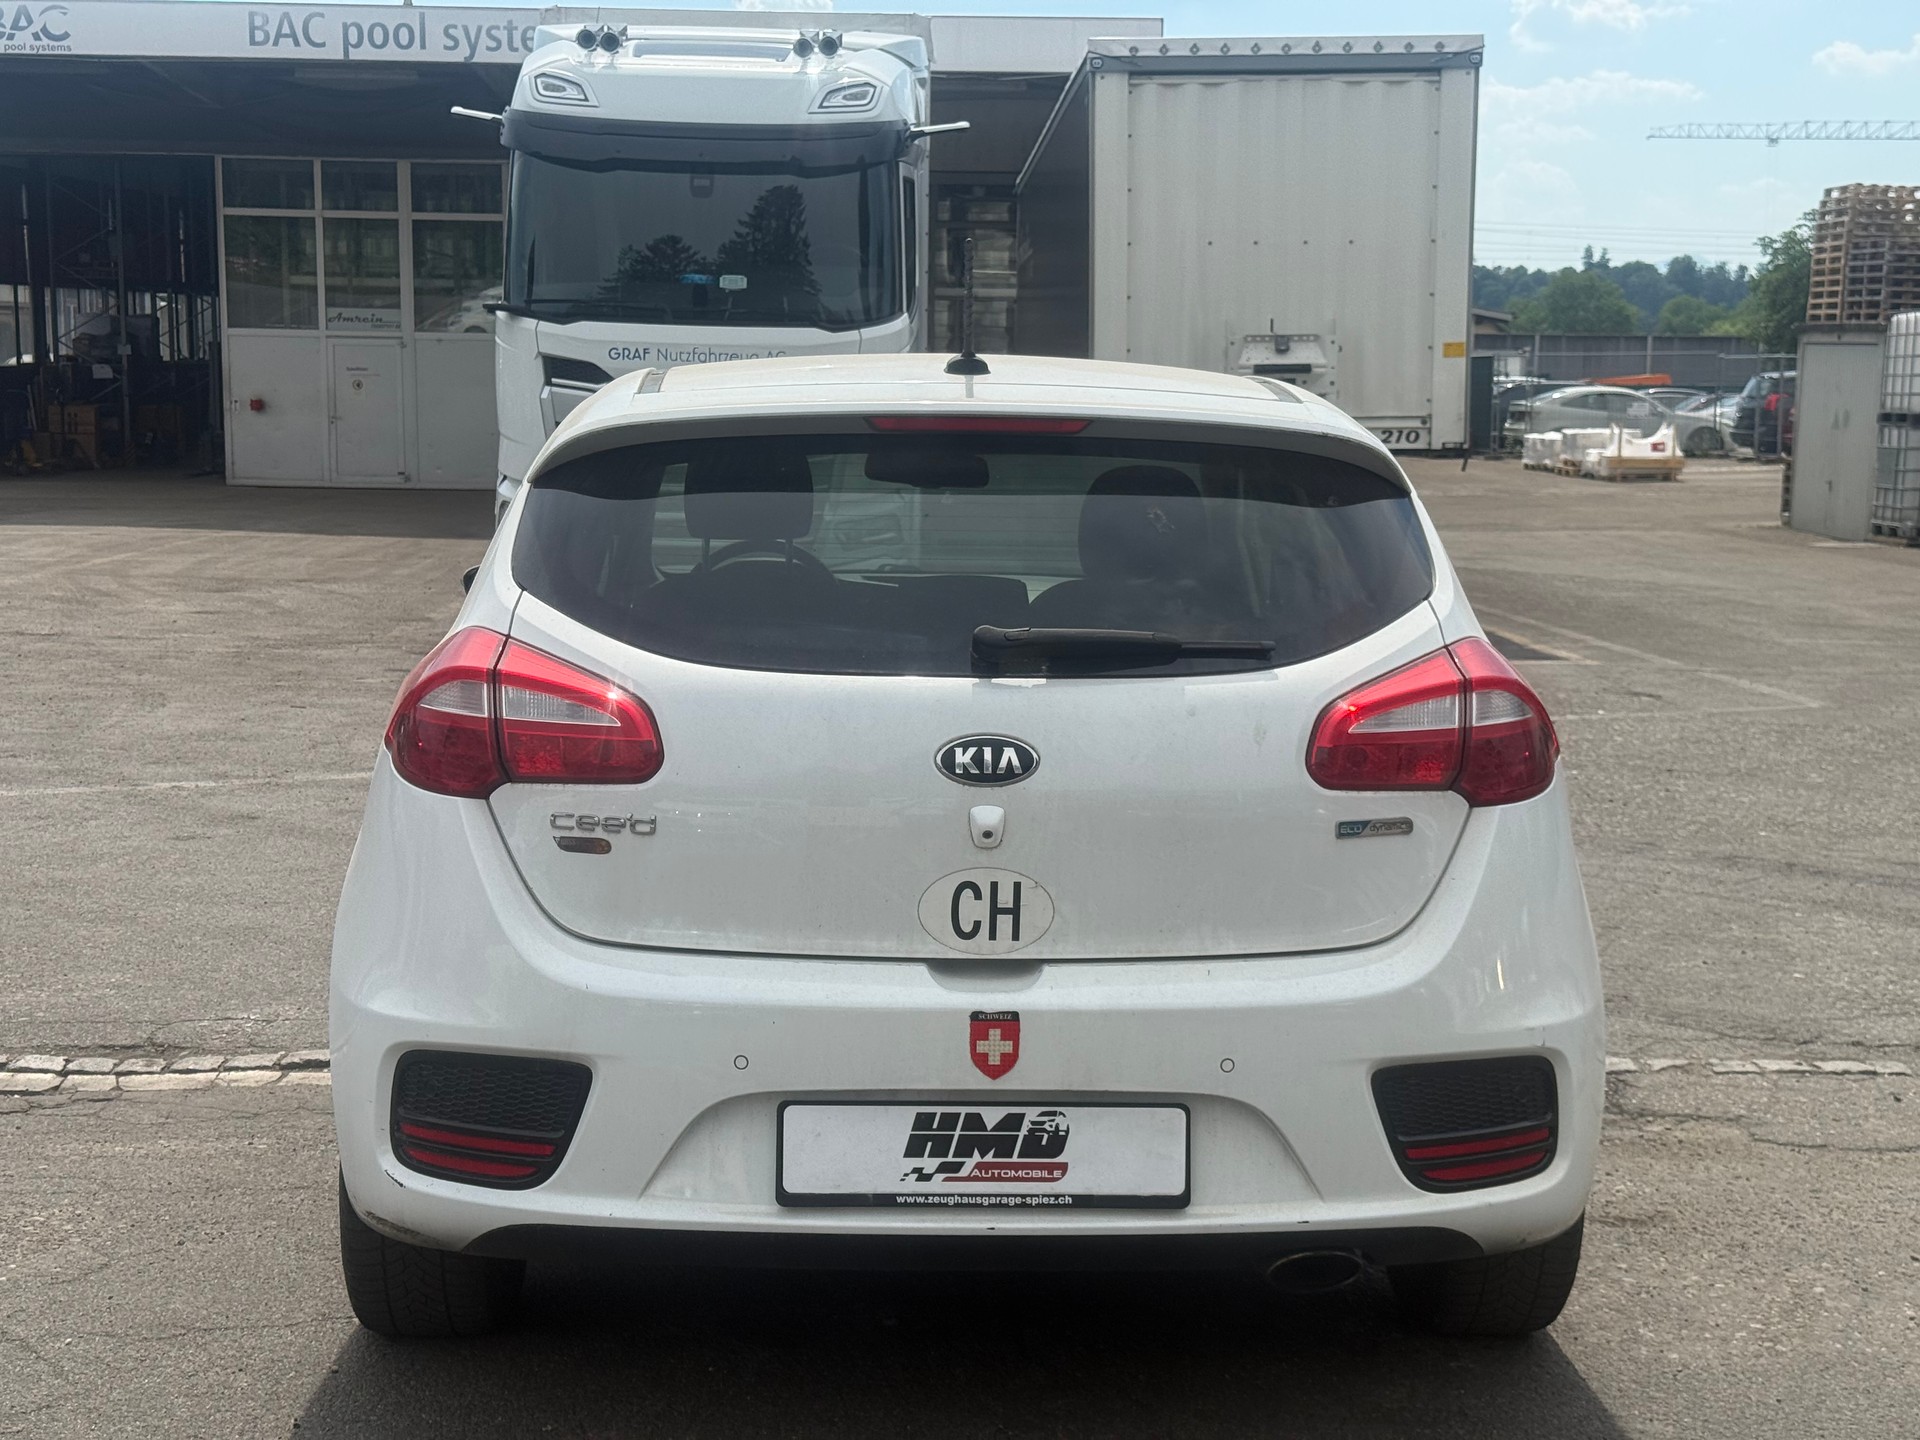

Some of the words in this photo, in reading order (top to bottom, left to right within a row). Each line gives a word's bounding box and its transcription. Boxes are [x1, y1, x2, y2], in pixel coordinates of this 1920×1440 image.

[0, 4, 71, 42] AC
[247, 11, 327, 48] BAC
[342, 12, 427, 60] pool
[4, 43, 26, 52] pool
[29, 43, 72, 54] systems
[608, 347, 651, 361] GRAF
[1381, 430, 1420, 444] 210
[953, 746, 1023, 774] KIA
[951, 880, 1022, 942] CH
[903, 1110, 1070, 1160] HMD
[970, 1168, 1063, 1178] AUTOMOBILE
[896, 1194, 1073, 1206] www.zeughausgarage-spiez.ch
